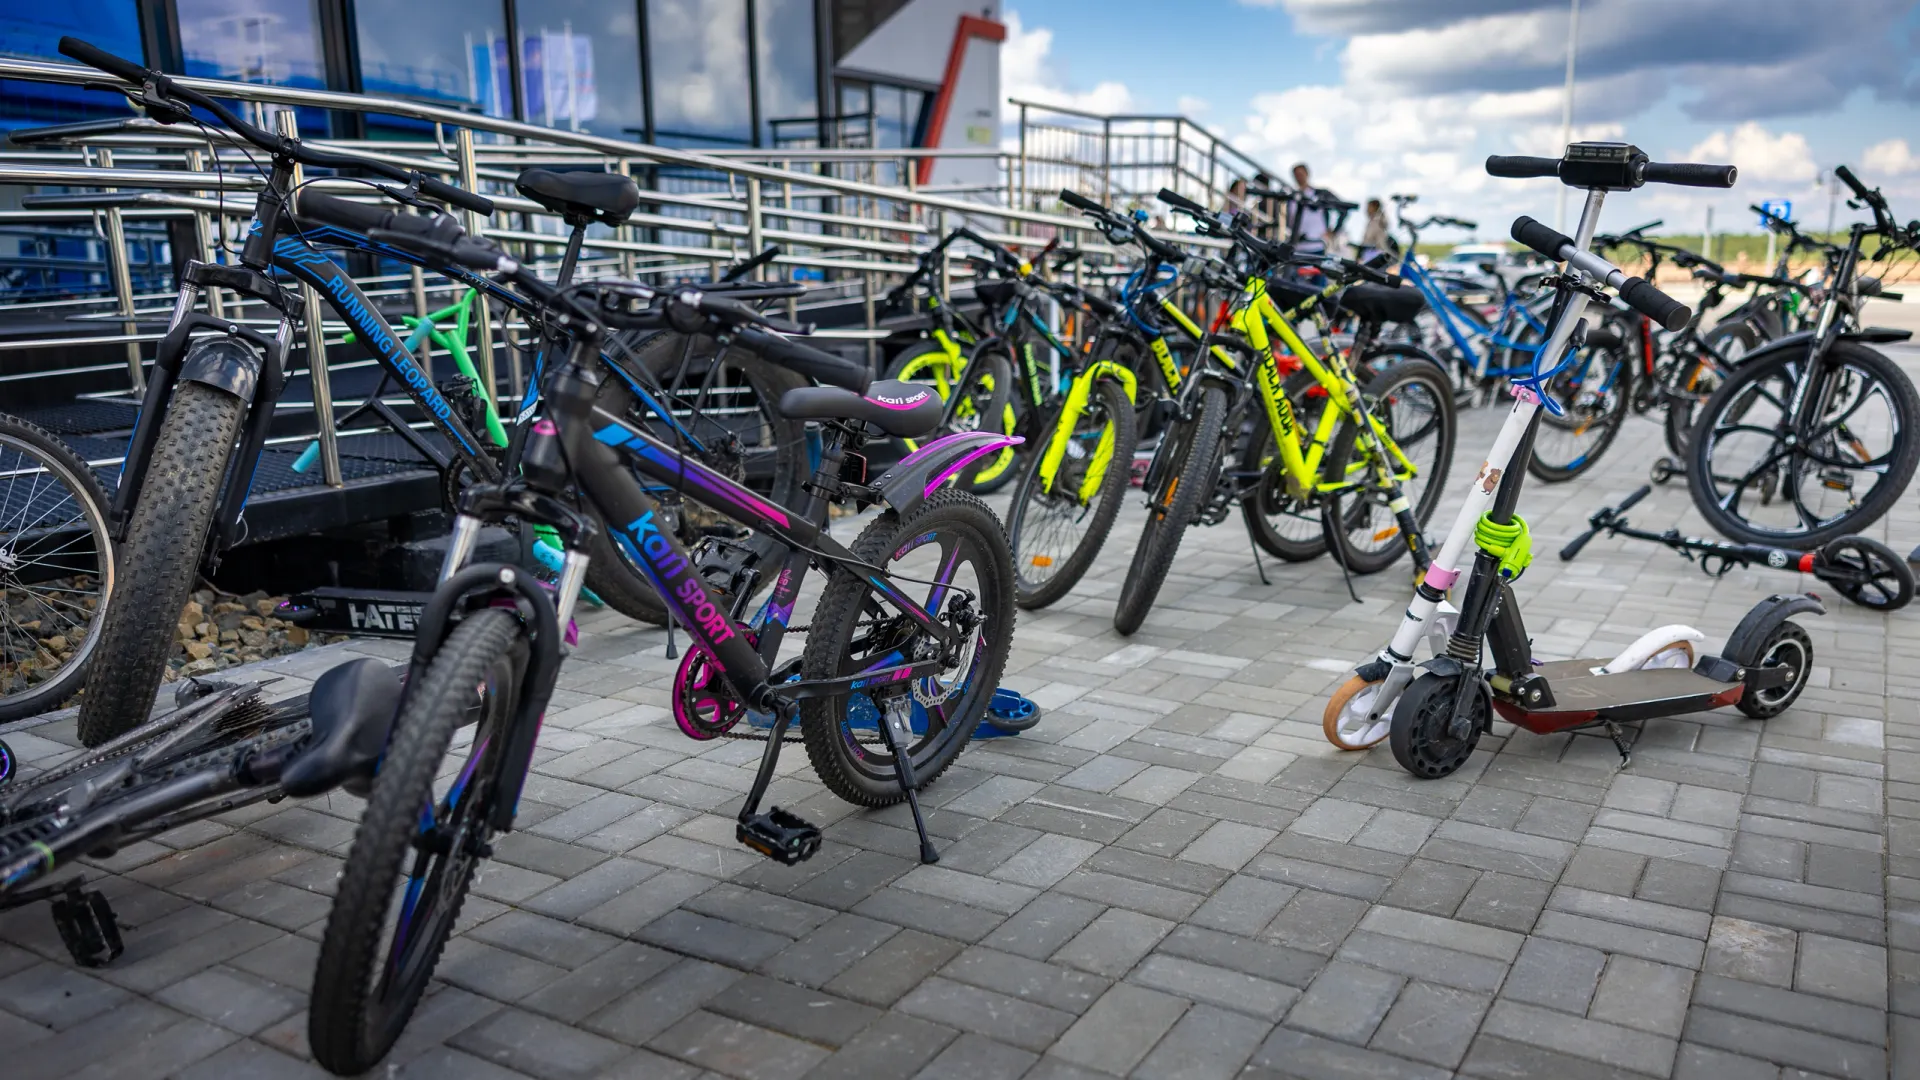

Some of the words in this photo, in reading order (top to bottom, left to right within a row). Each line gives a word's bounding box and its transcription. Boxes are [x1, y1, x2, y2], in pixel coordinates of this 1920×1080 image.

[327, 275, 394, 354] RUNNING
[389, 350, 451, 420] LEOPARD
[905, 390, 928, 404] SPORT
[676, 578, 735, 645] SPORT
